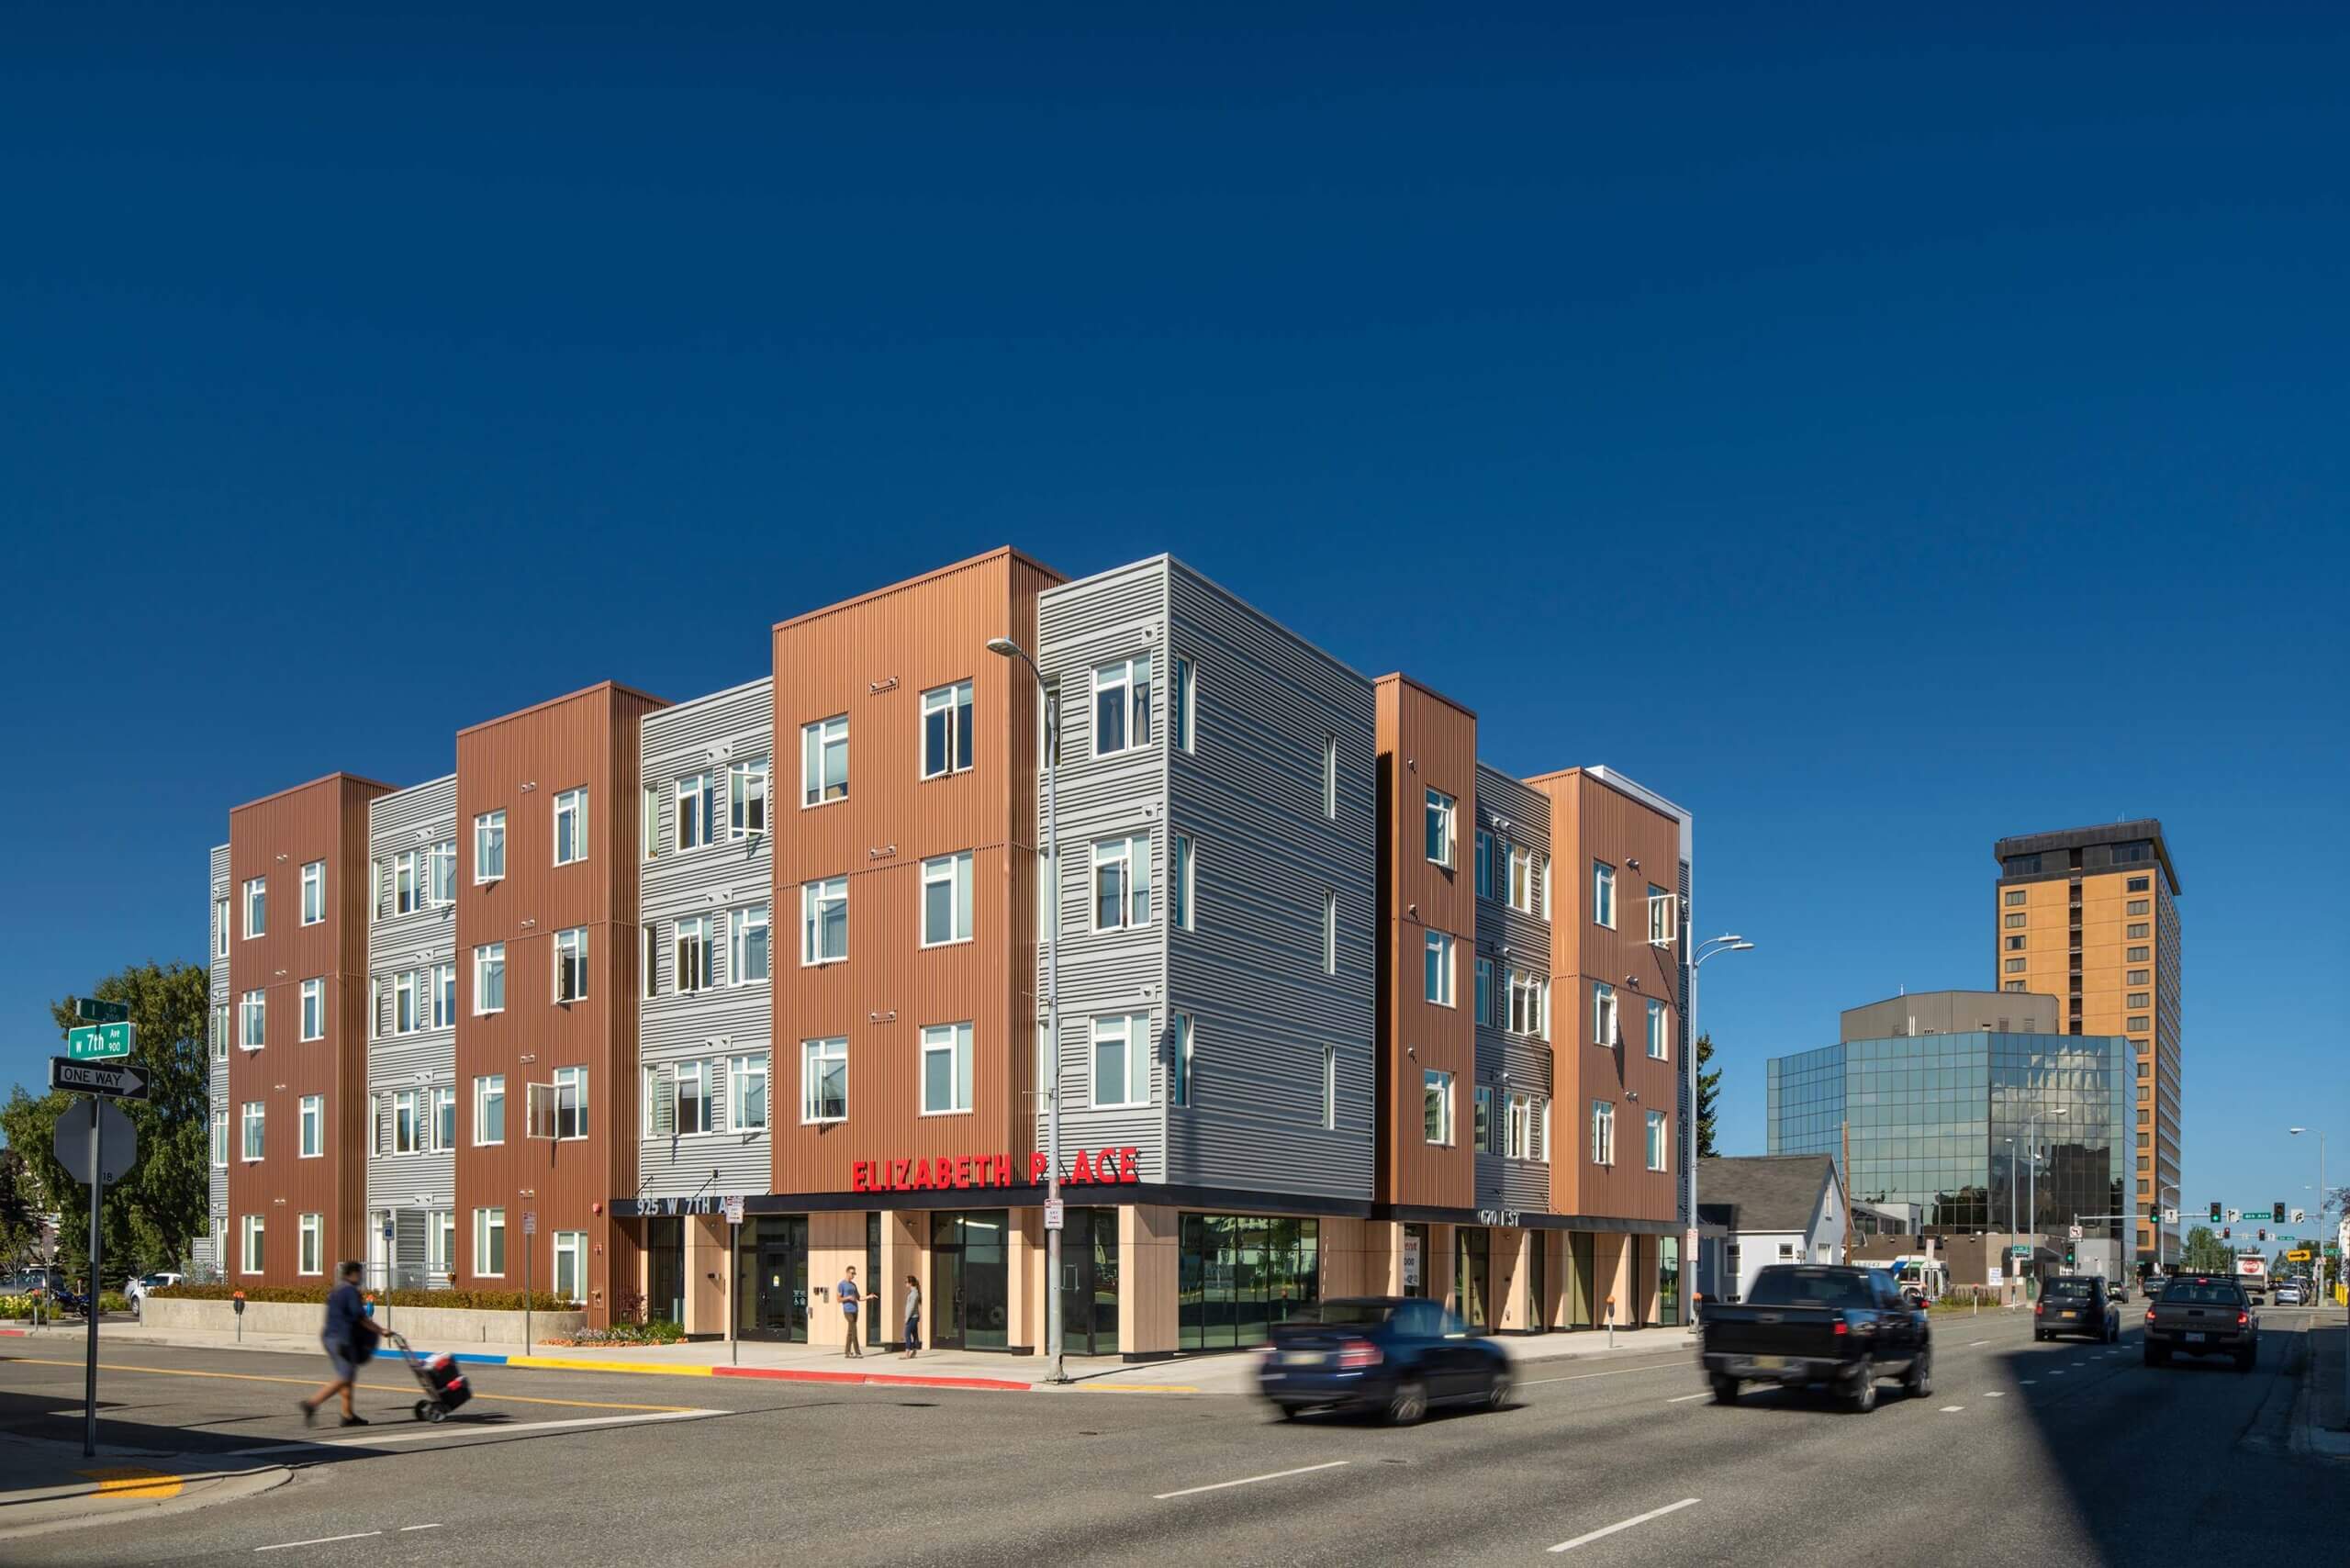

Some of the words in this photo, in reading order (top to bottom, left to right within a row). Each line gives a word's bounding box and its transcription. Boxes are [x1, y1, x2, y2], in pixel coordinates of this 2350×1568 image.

[75, 1040, 83, 1053] W
[86, 1033, 104, 1051] 7th
[110, 1028, 120, 1038] Ave
[108, 1042, 121, 1052] 900
[64, 1068, 90, 1083] ONE
[95, 1070, 122, 1086] WAY
[103, 1171, 113, 1182] 18
[852, 1153, 1011, 1193] ELIZABETH
[1029, 1147, 1138, 1186] PACE
[637, 1198, 659, 1215] 925
[667, 1198, 678, 1215] W
[685, 1197, 711, 1215] 7TH
[1508, 1211, 1520, 1227] ST
